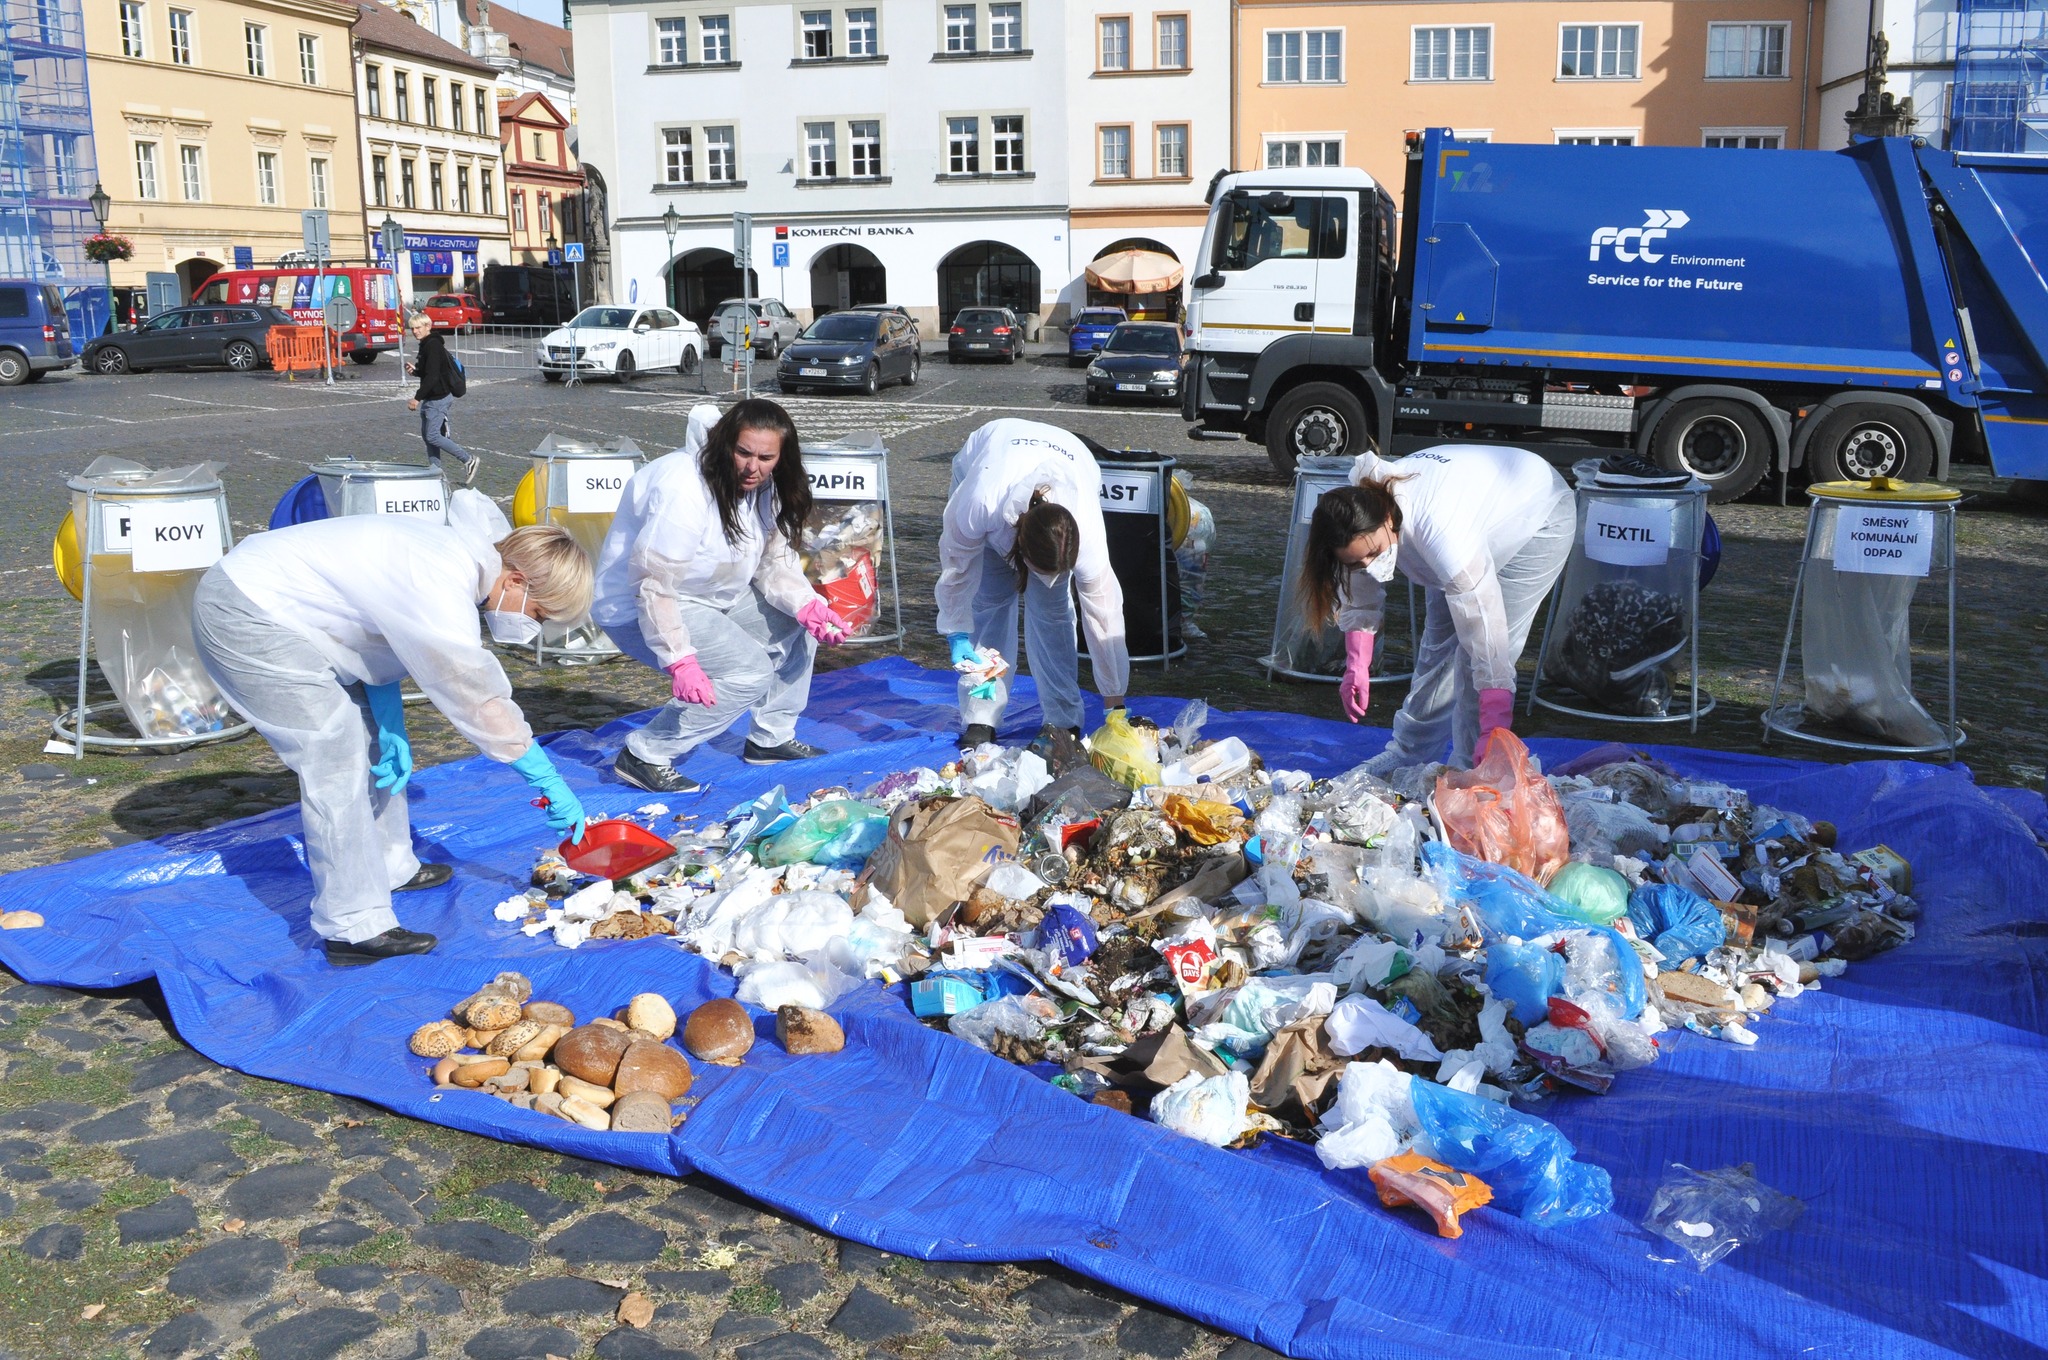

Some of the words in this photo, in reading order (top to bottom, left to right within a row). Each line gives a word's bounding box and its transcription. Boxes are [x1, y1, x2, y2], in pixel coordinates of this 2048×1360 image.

[791, 226, 862, 237] KOMERČNÍ
[867, 227, 914, 236] BANKA
[376, 235, 428, 247] ETRA
[429, 239, 478, 248] H-CENTRUM
[1589, 226, 1668, 264] FCC
[1670, 254, 1746, 267] Environment
[775, 245, 786, 260] P
[1588, 274, 1640, 286] Service
[1643, 275, 1664, 287] for
[1668, 277, 1692, 288] the
[1695, 278, 1743, 291] Future
[1400, 406, 1430, 415] MAN
[586, 477, 622, 490] SKLO
[807, 471, 865, 490] PAPÍR
[385, 499, 441, 513] ELEKTRO
[1862, 515, 1910, 528] SMĚSNÝ
[155, 524, 204, 542] KOVY
[1597, 522, 1656, 543] TEXTIL
[1850, 531, 1919, 544] KOMUNÁLNÍ
[1863, 547, 1903, 558] ODPAD
[1183, 969, 1200, 978] DAYS
